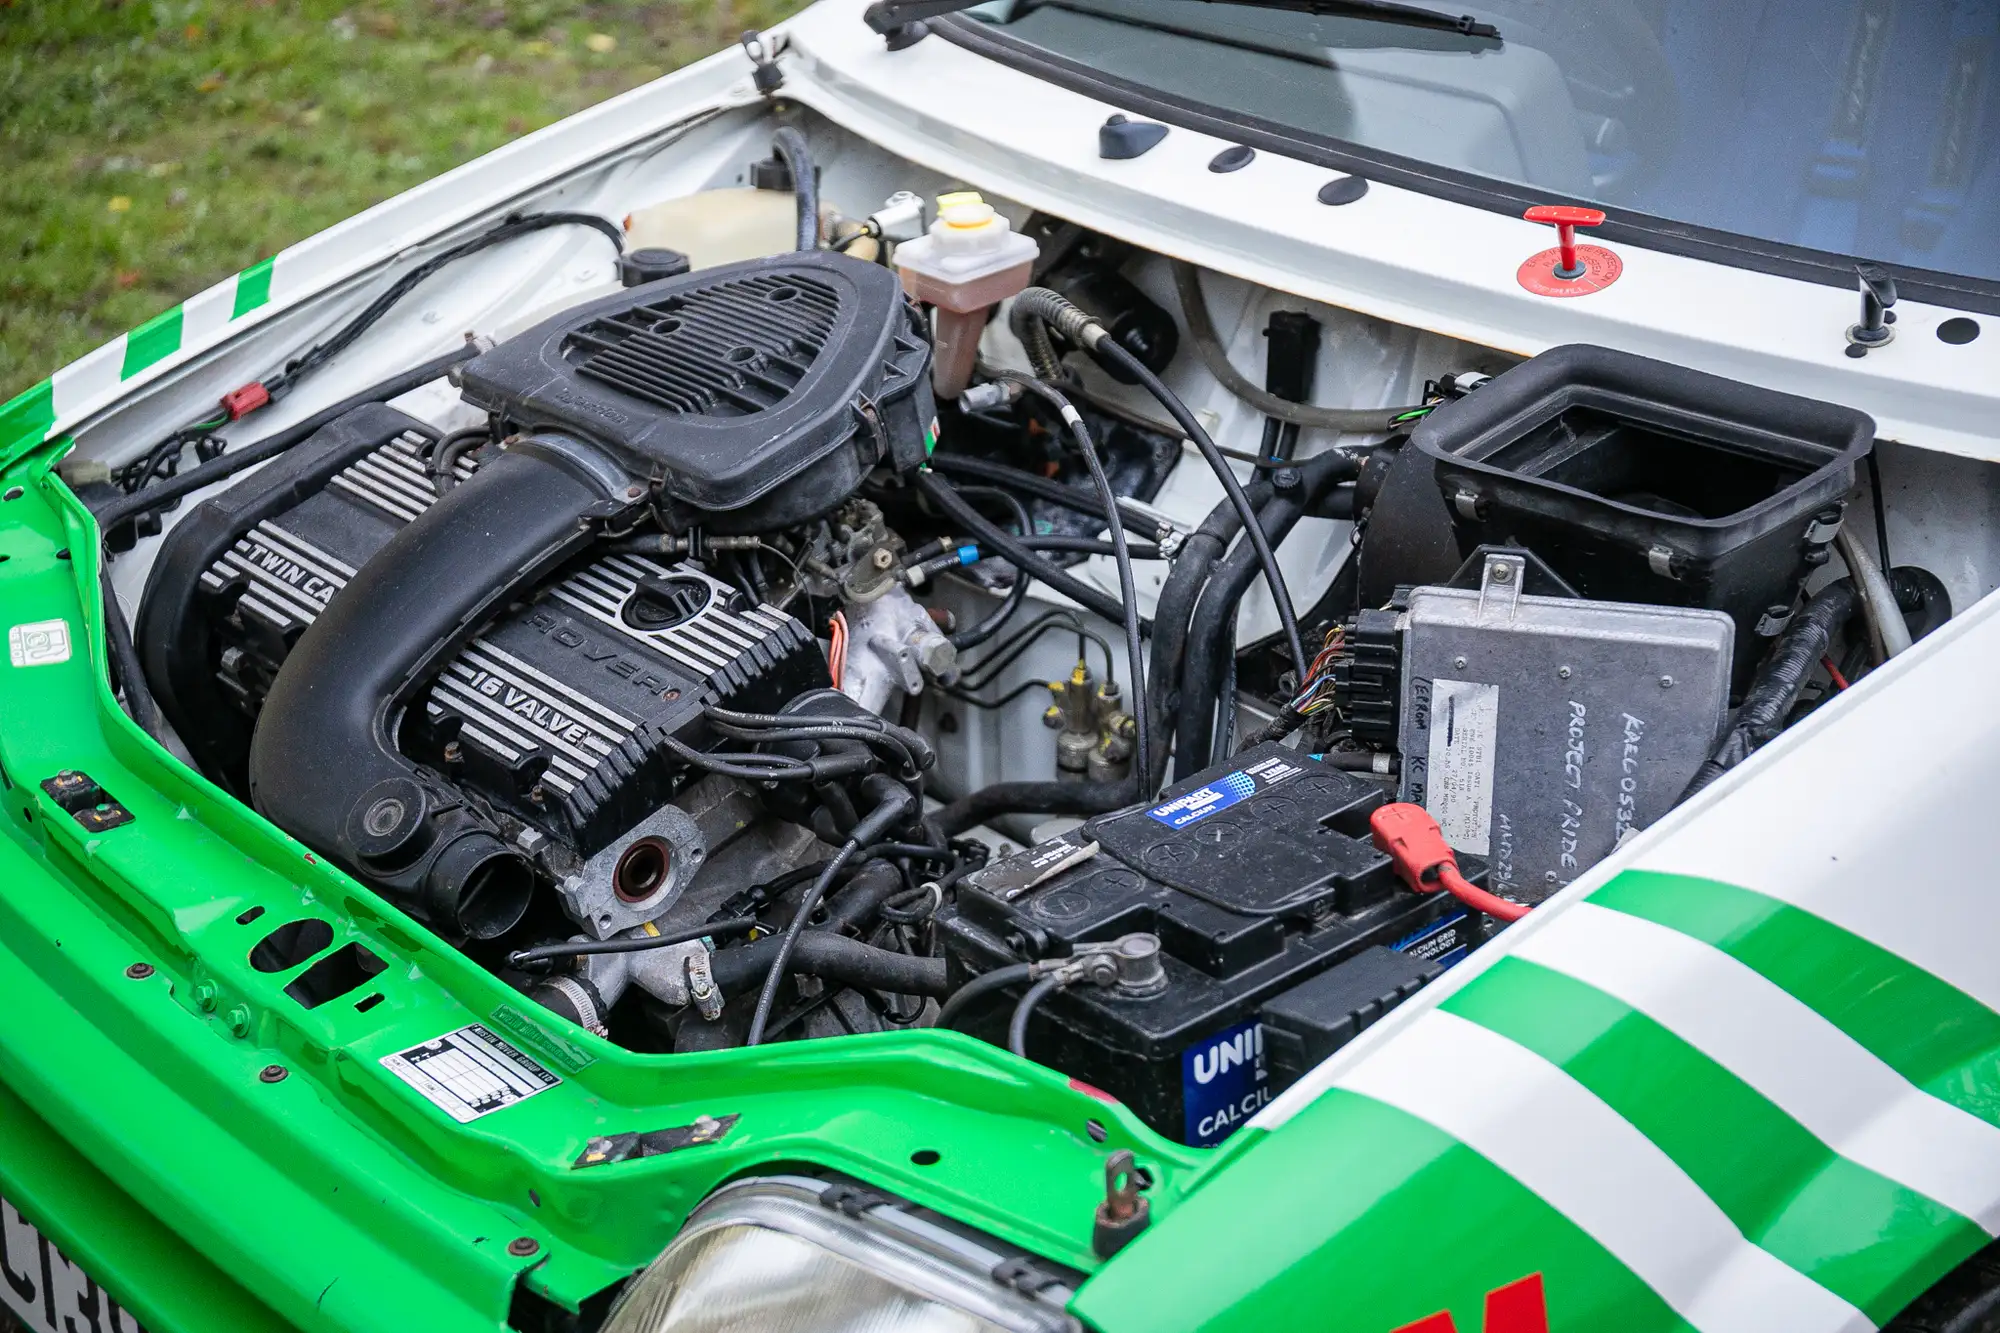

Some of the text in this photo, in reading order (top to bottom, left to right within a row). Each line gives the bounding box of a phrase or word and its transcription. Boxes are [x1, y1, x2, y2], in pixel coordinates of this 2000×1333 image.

[248, 544, 306, 584] TWIN
[524, 611, 669, 695] ROVER
[470, 671, 589, 744] 16 VALVE
[1153, 787, 1214, 816] UNIPART
[1560, 700, 1587, 870] PROJECT PRIDE
[1174, 804, 1217, 825] CALCIUM
[473, 1026, 554, 1084] AUSTIN ROVER GROUP LTD
